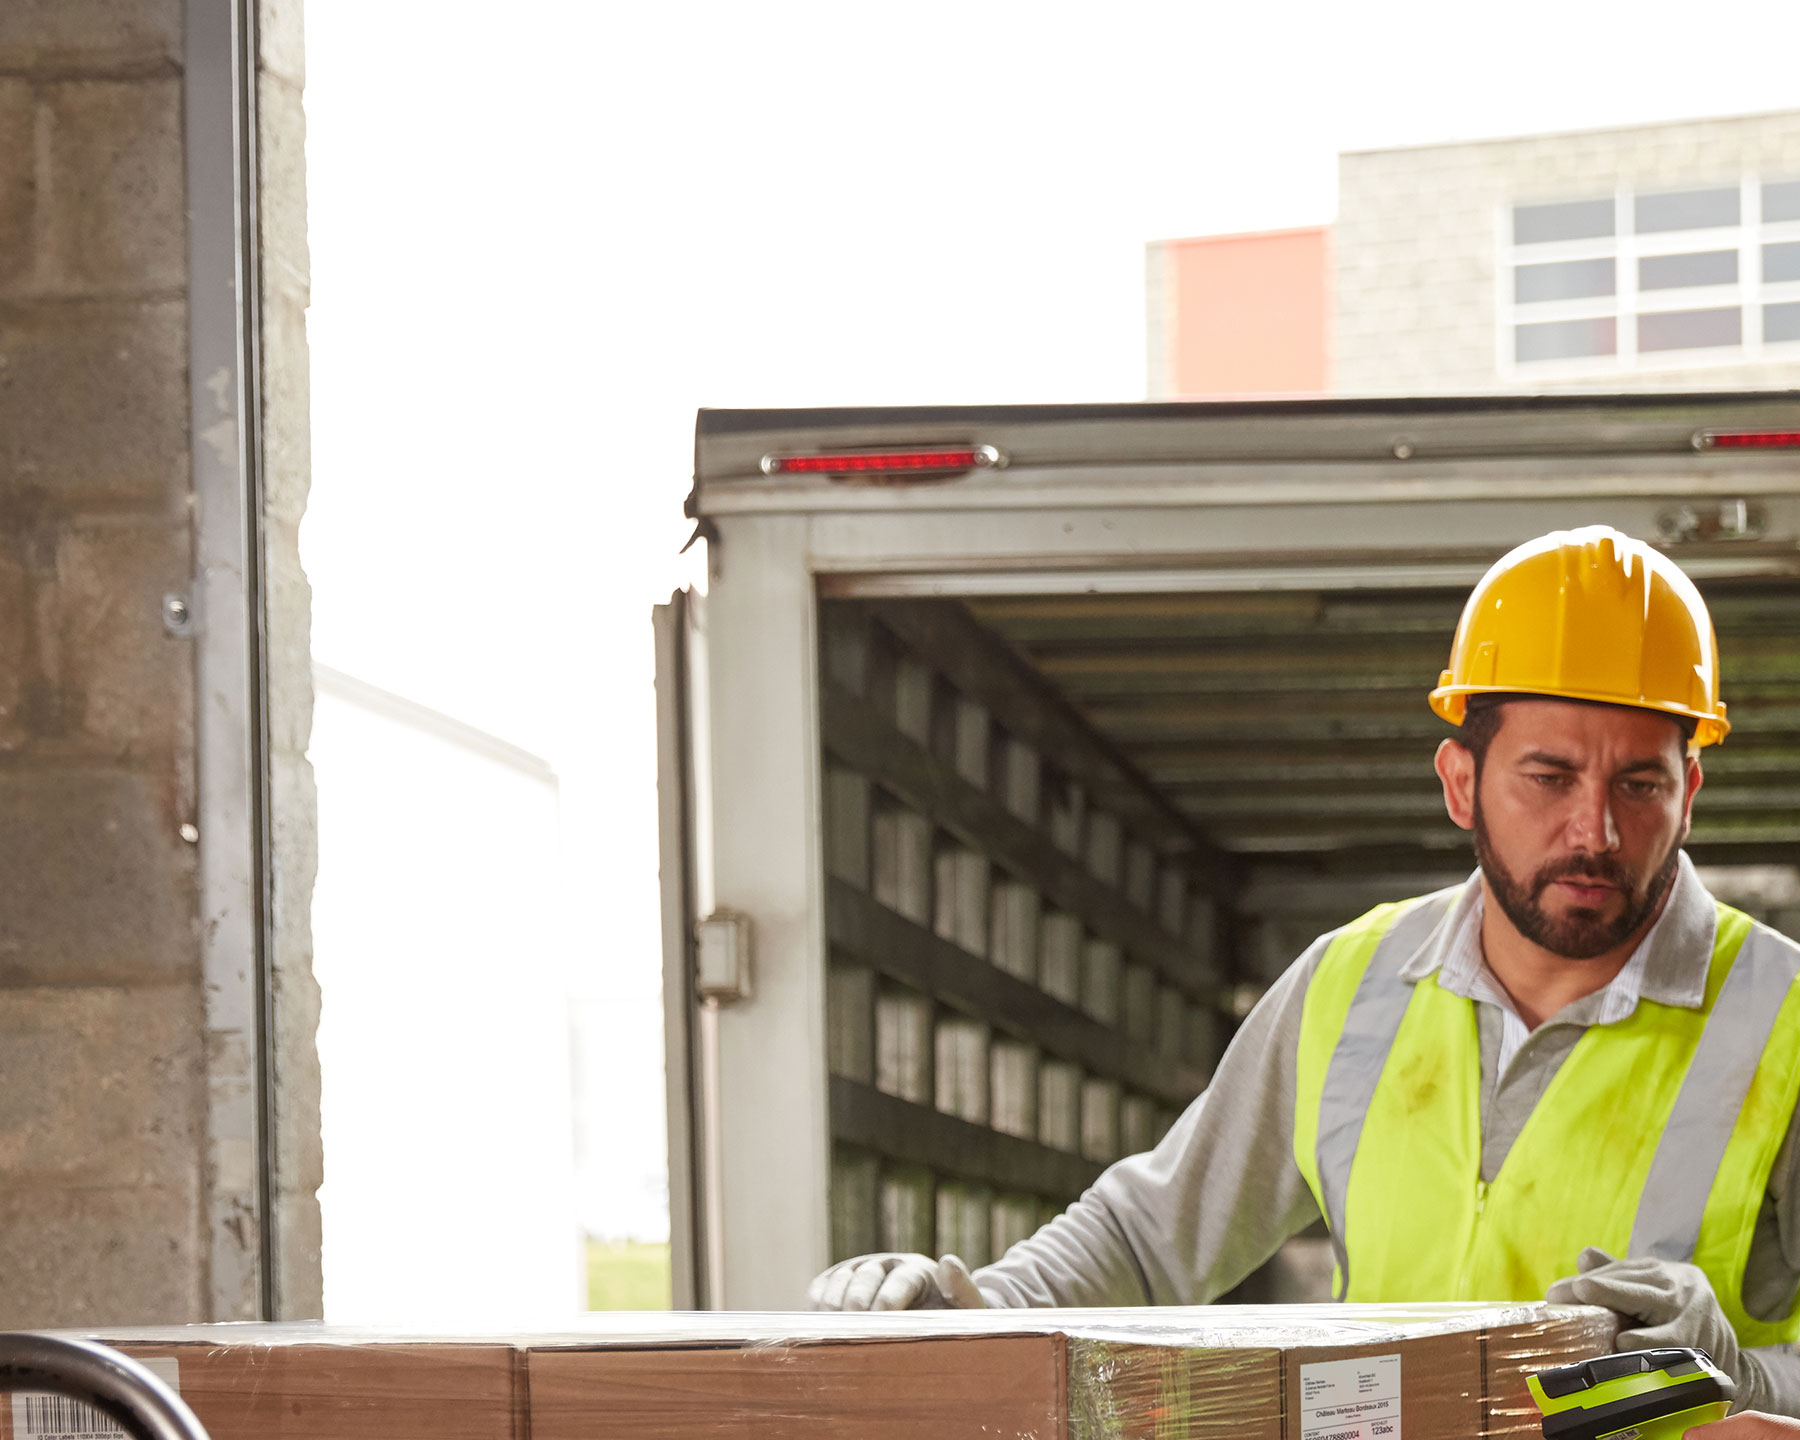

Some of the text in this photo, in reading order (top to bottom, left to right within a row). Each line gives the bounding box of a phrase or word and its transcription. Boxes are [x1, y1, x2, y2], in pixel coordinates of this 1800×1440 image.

[1356, 1405, 1377, 1413] Bordeaux
[1377, 1401, 1389, 1409] 2015
[1372, 1426, 1393, 1435] 123abc
